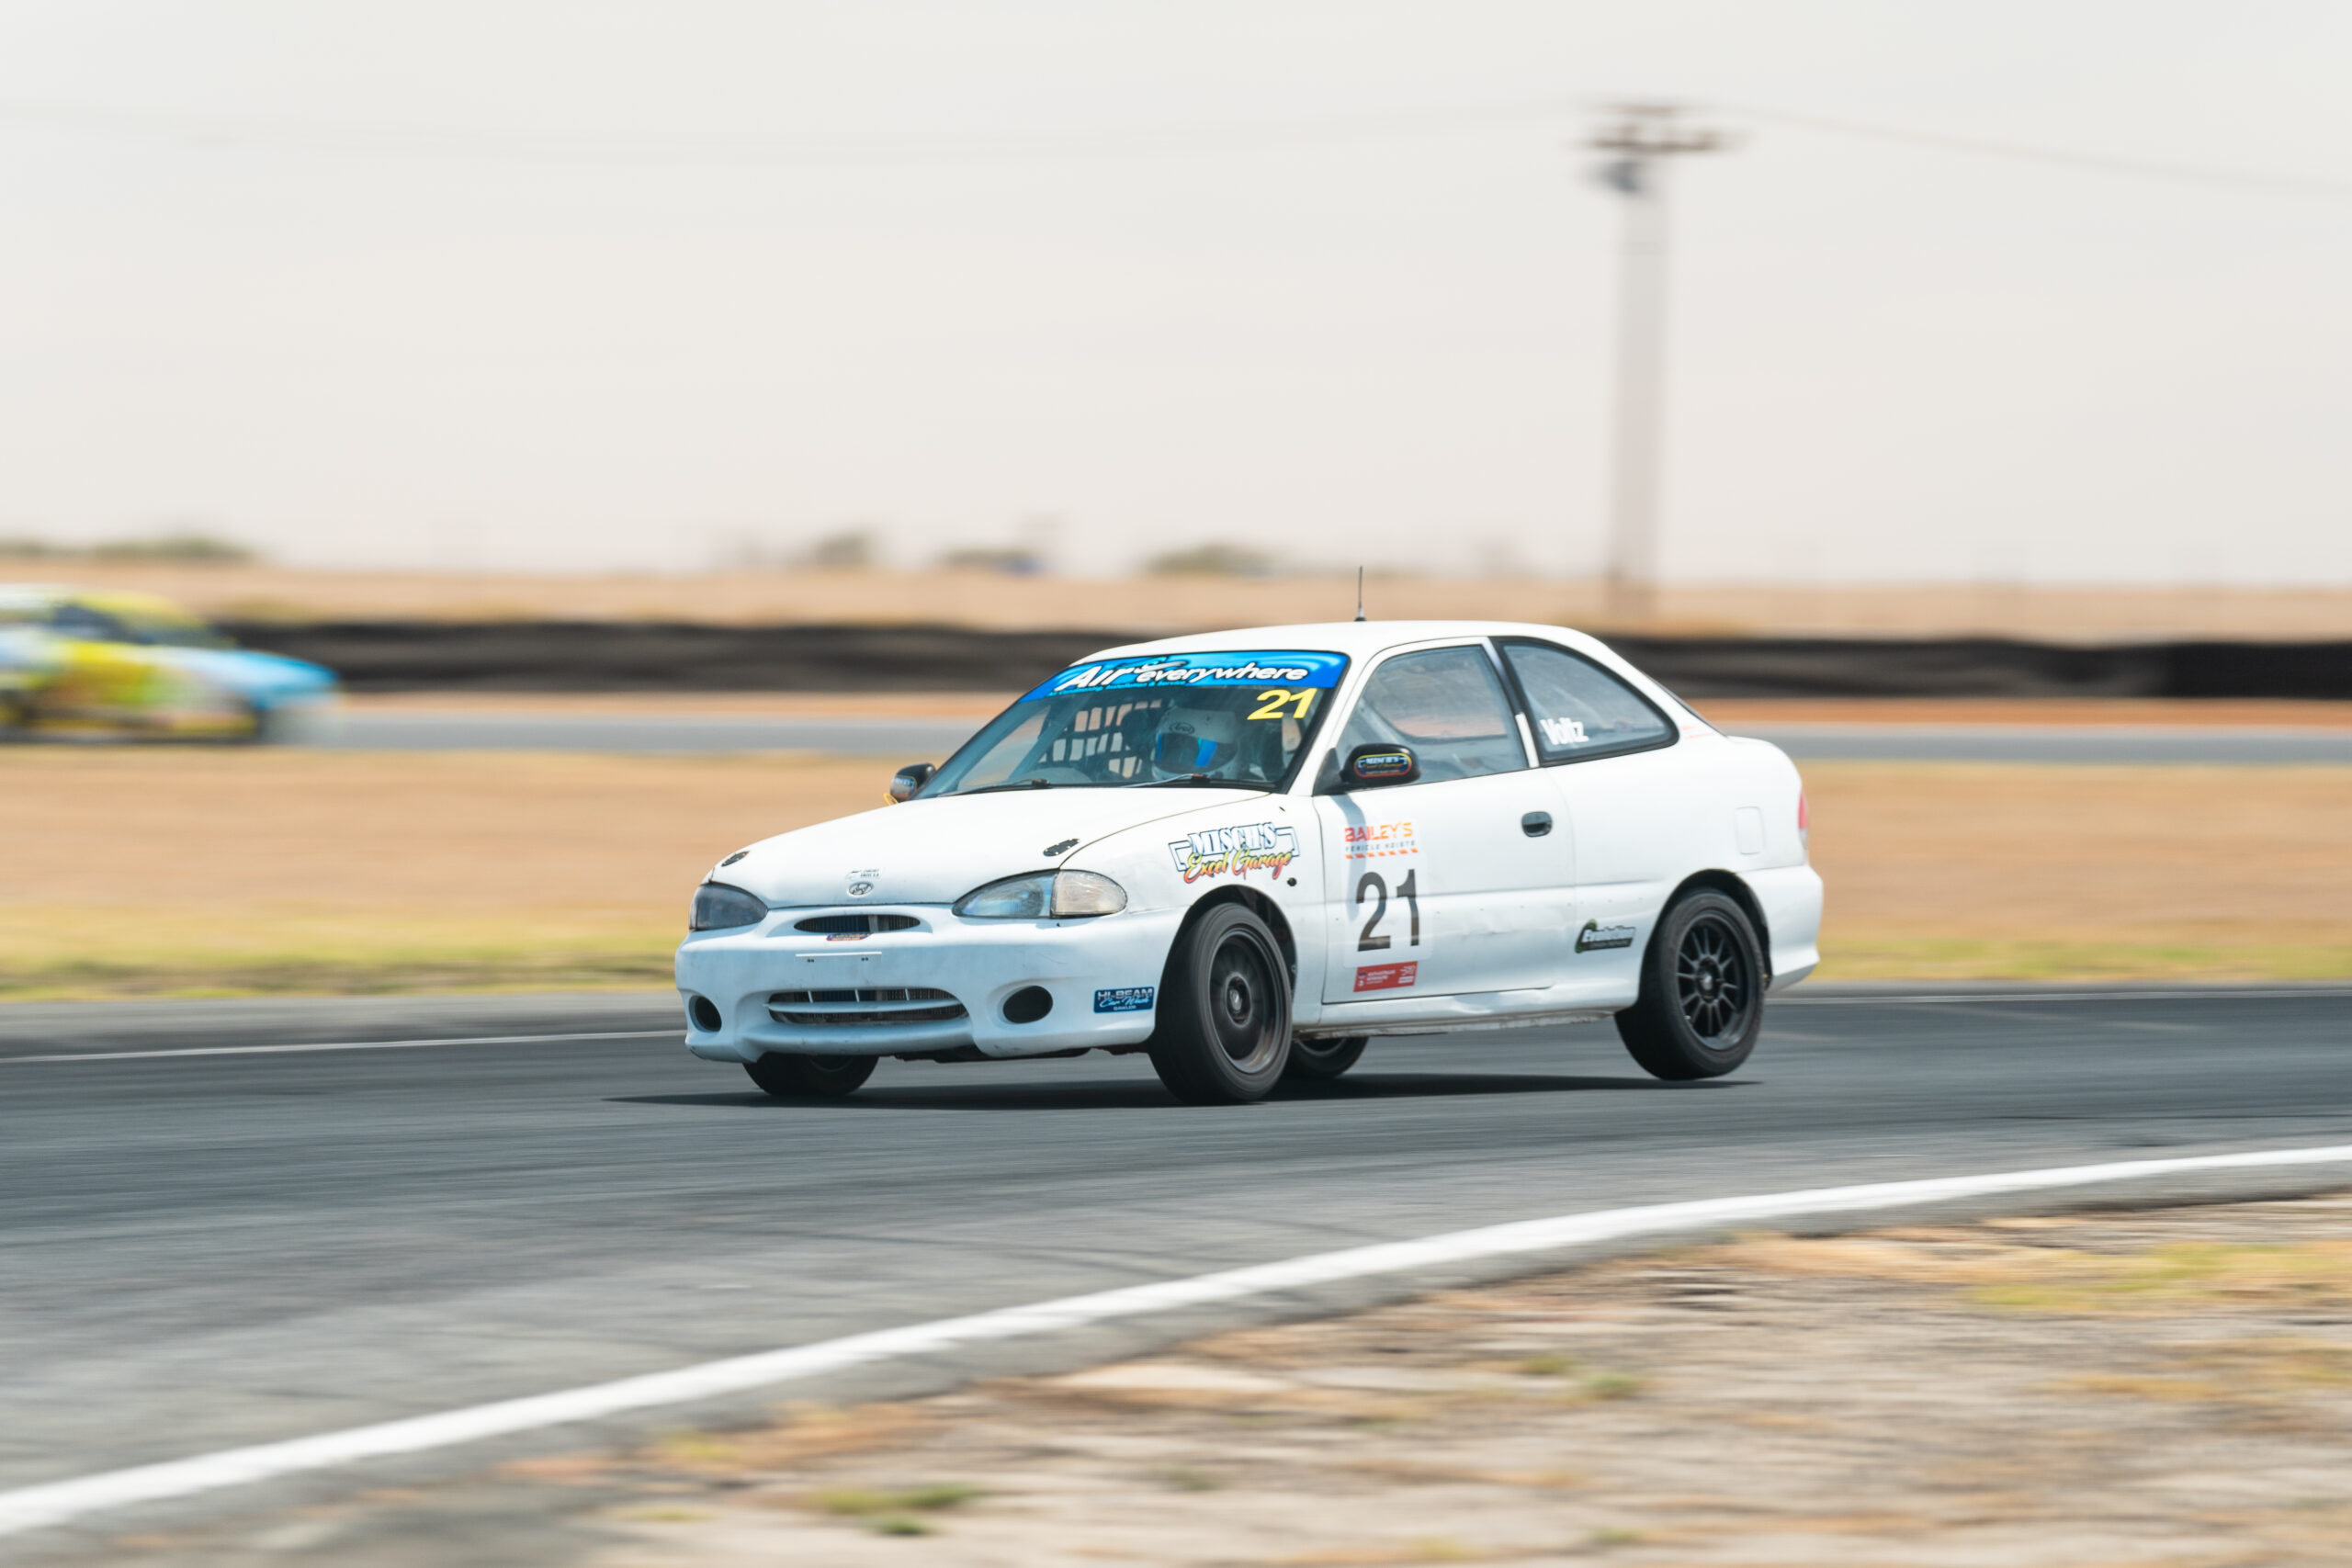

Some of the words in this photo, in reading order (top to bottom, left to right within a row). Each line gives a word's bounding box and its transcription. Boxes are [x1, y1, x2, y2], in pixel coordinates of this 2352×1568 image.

[1136, 661, 1308, 683] everywhere
[1247, 688, 1317, 720] 21
[1231, 847, 1293, 880] Garage
[1356, 869, 1419, 952] 21
[1098, 988, 1153, 999] HI-BEAM
